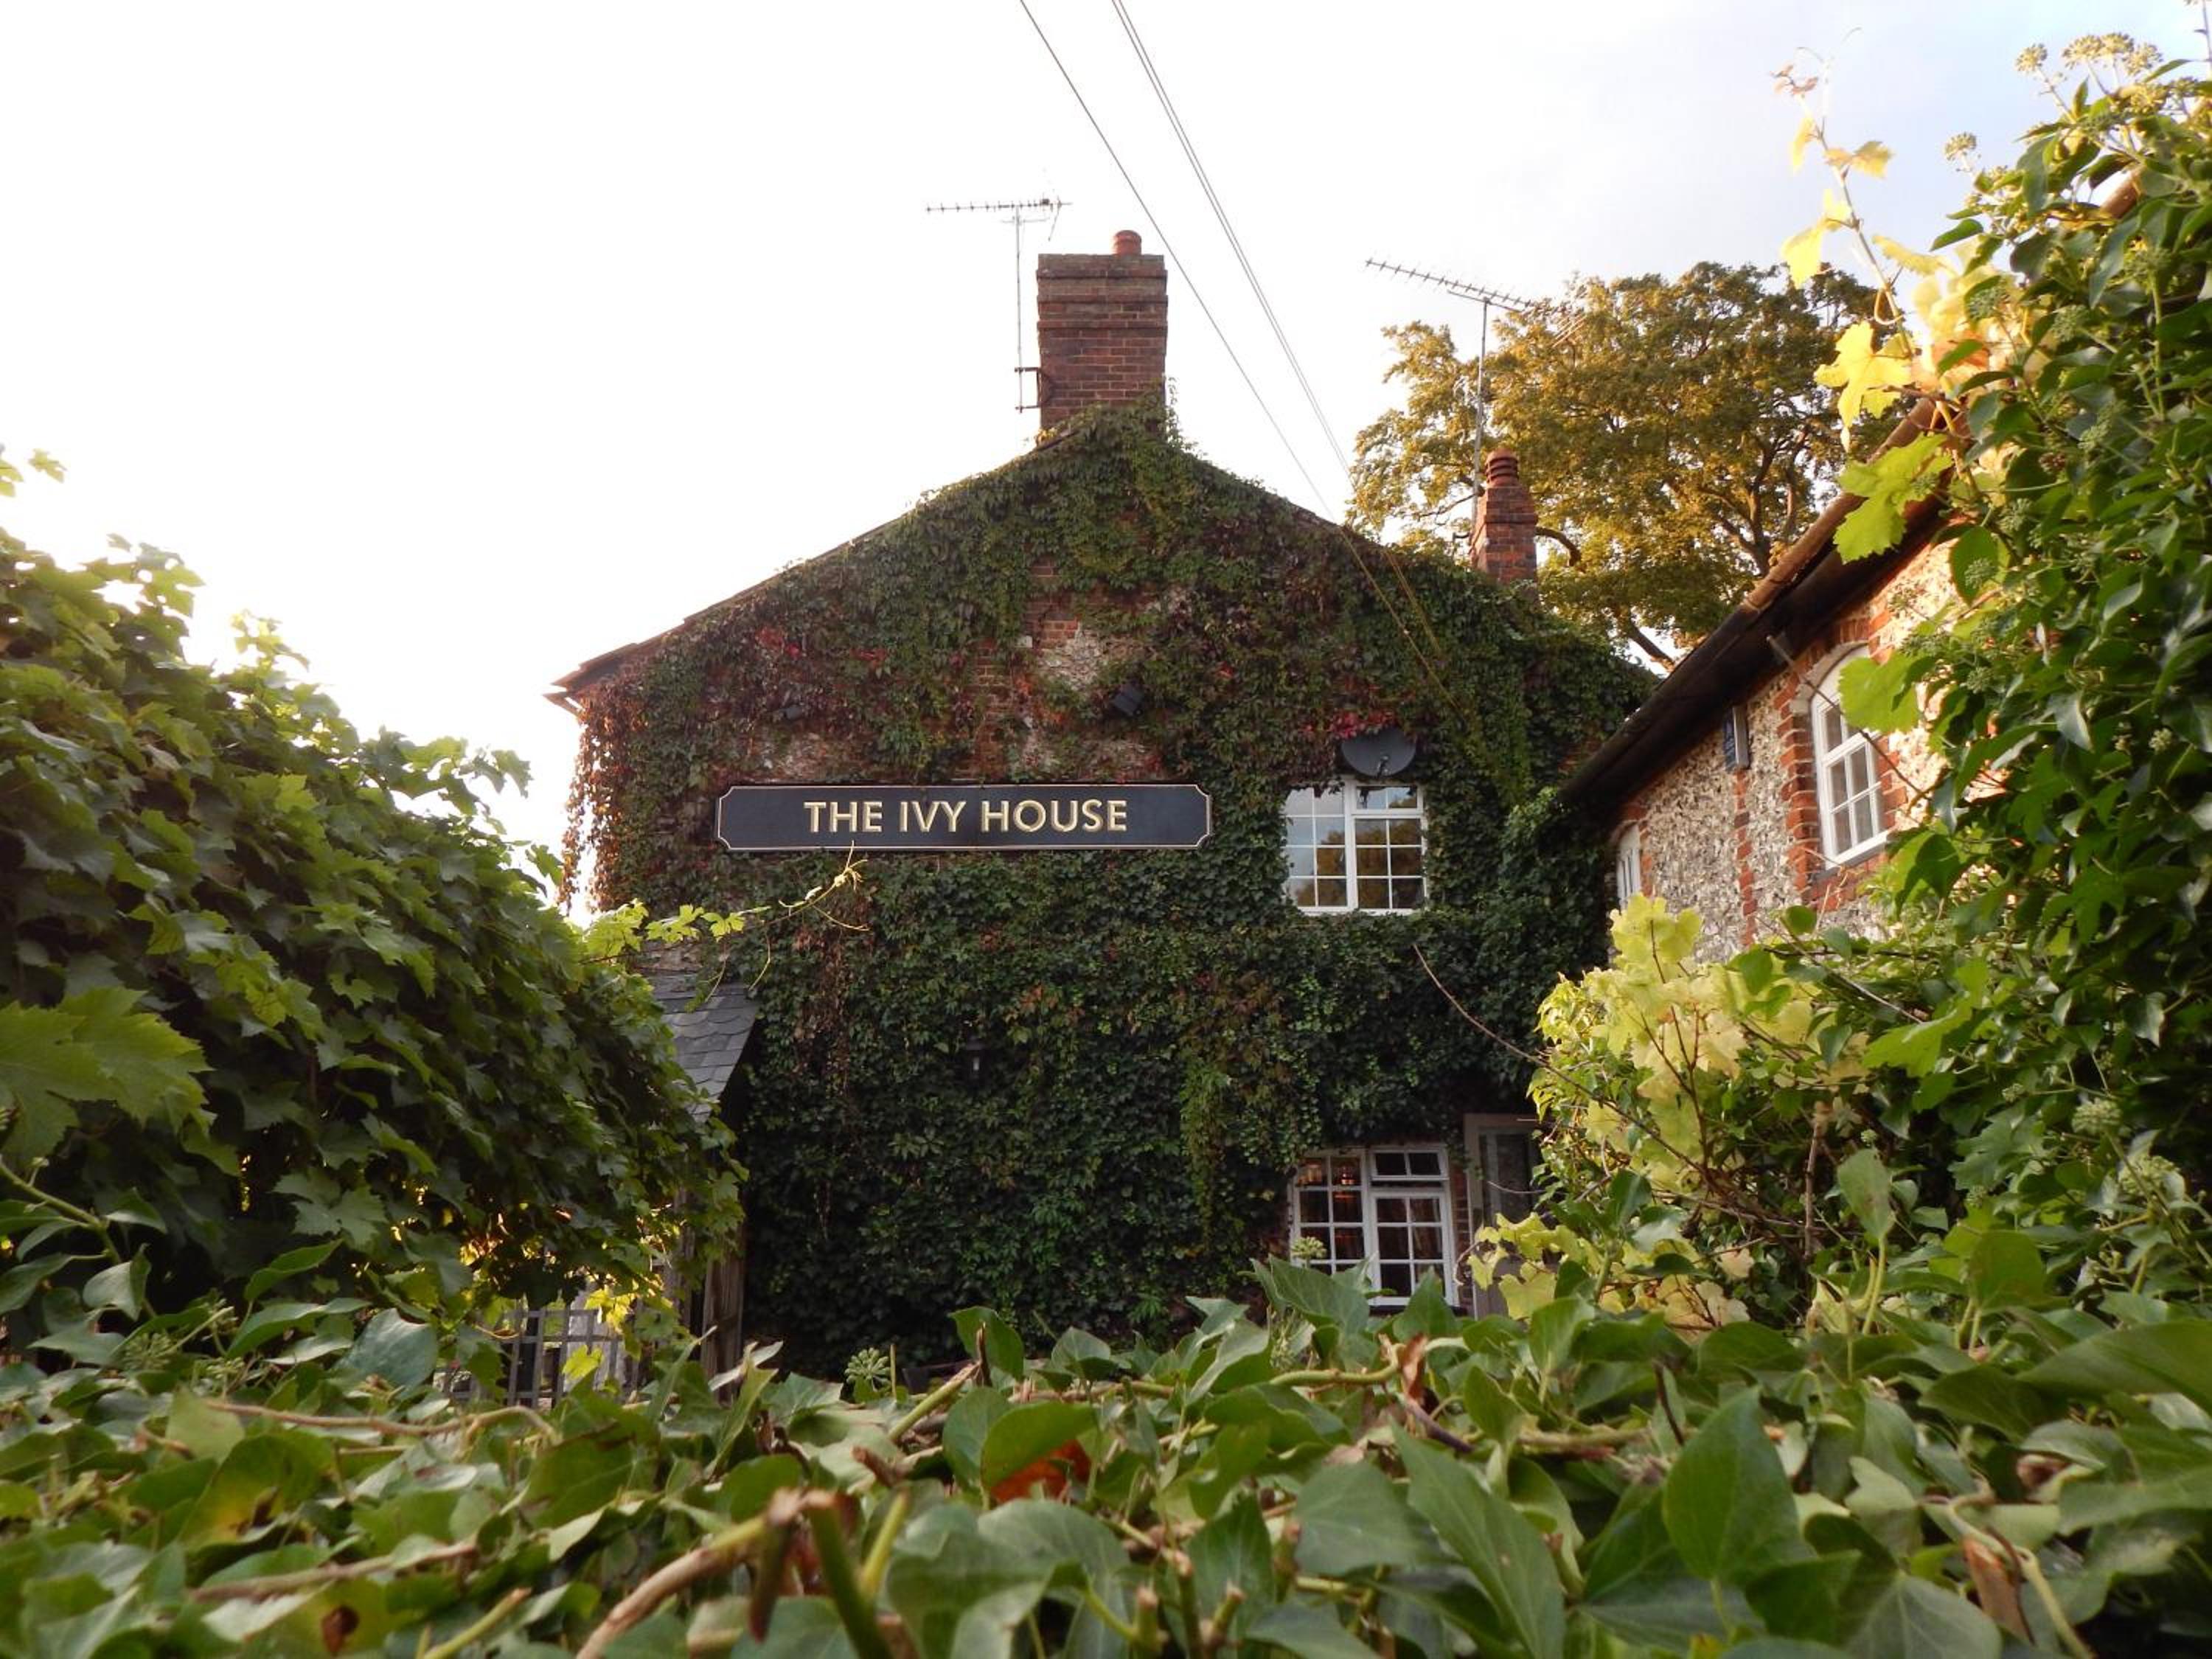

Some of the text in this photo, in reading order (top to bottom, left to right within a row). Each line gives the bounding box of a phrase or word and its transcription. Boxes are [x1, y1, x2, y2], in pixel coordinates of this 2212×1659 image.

[804, 799, 1127, 832] THE IVY HOUSE
